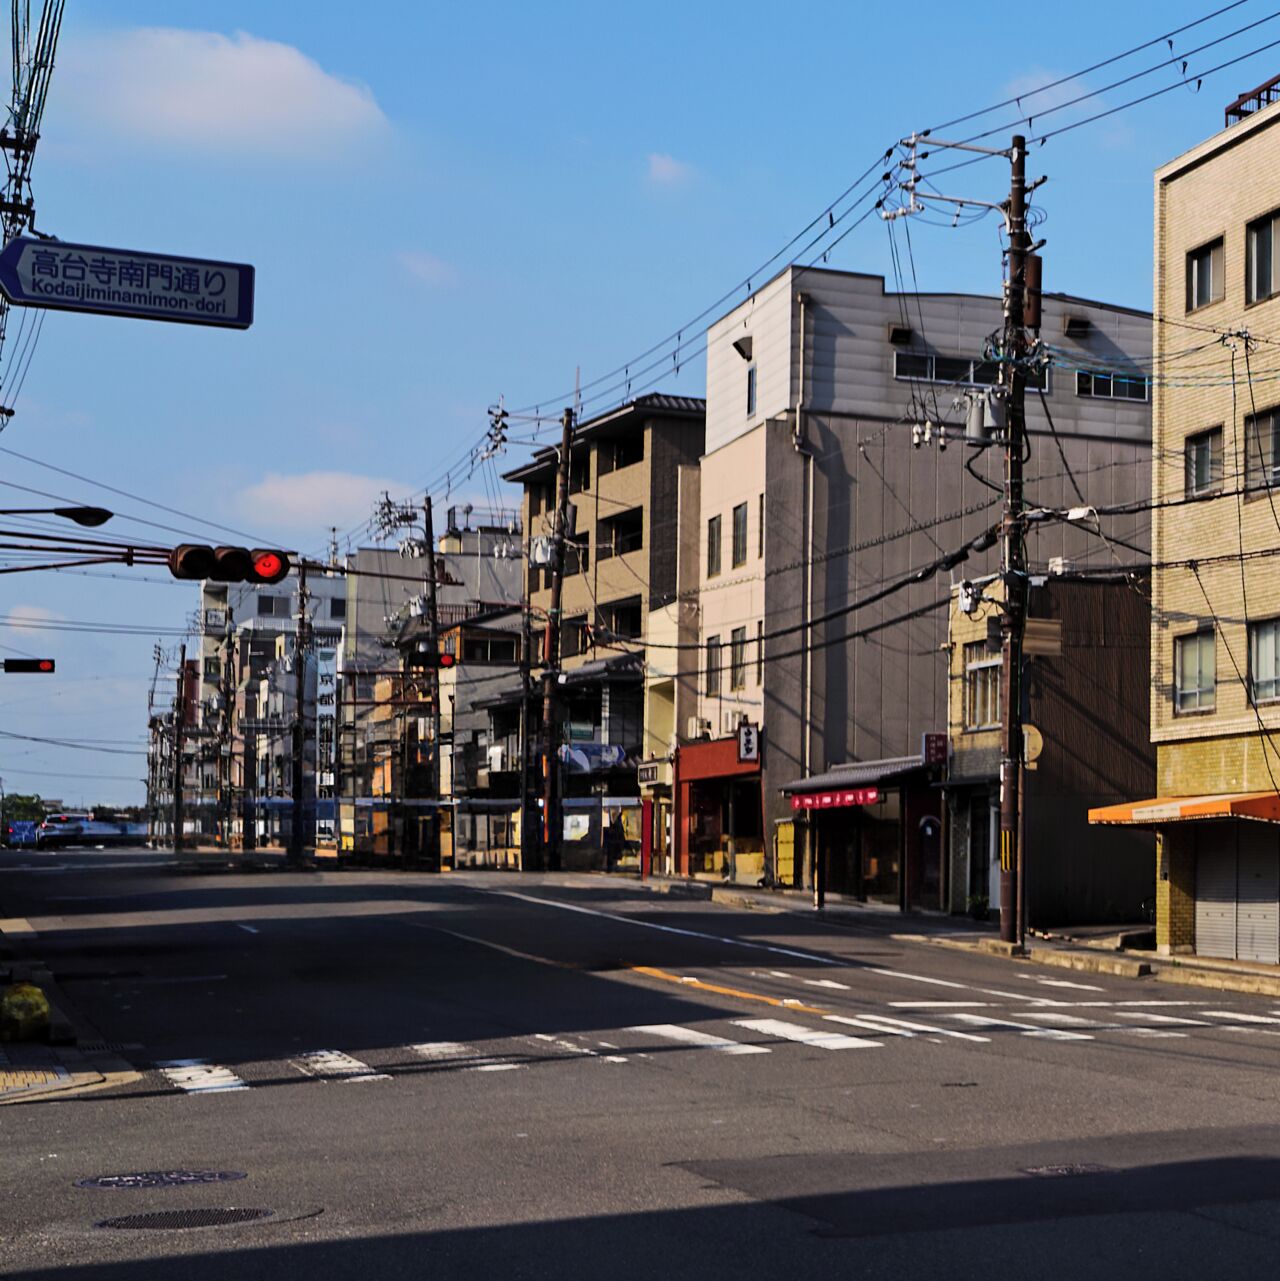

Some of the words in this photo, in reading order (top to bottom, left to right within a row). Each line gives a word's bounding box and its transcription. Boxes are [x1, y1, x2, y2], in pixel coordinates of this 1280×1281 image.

[31, 249, 226, 297] 高台寺南門通り
[31, 278, 226, 314] Kodaijiminamimon-dori
